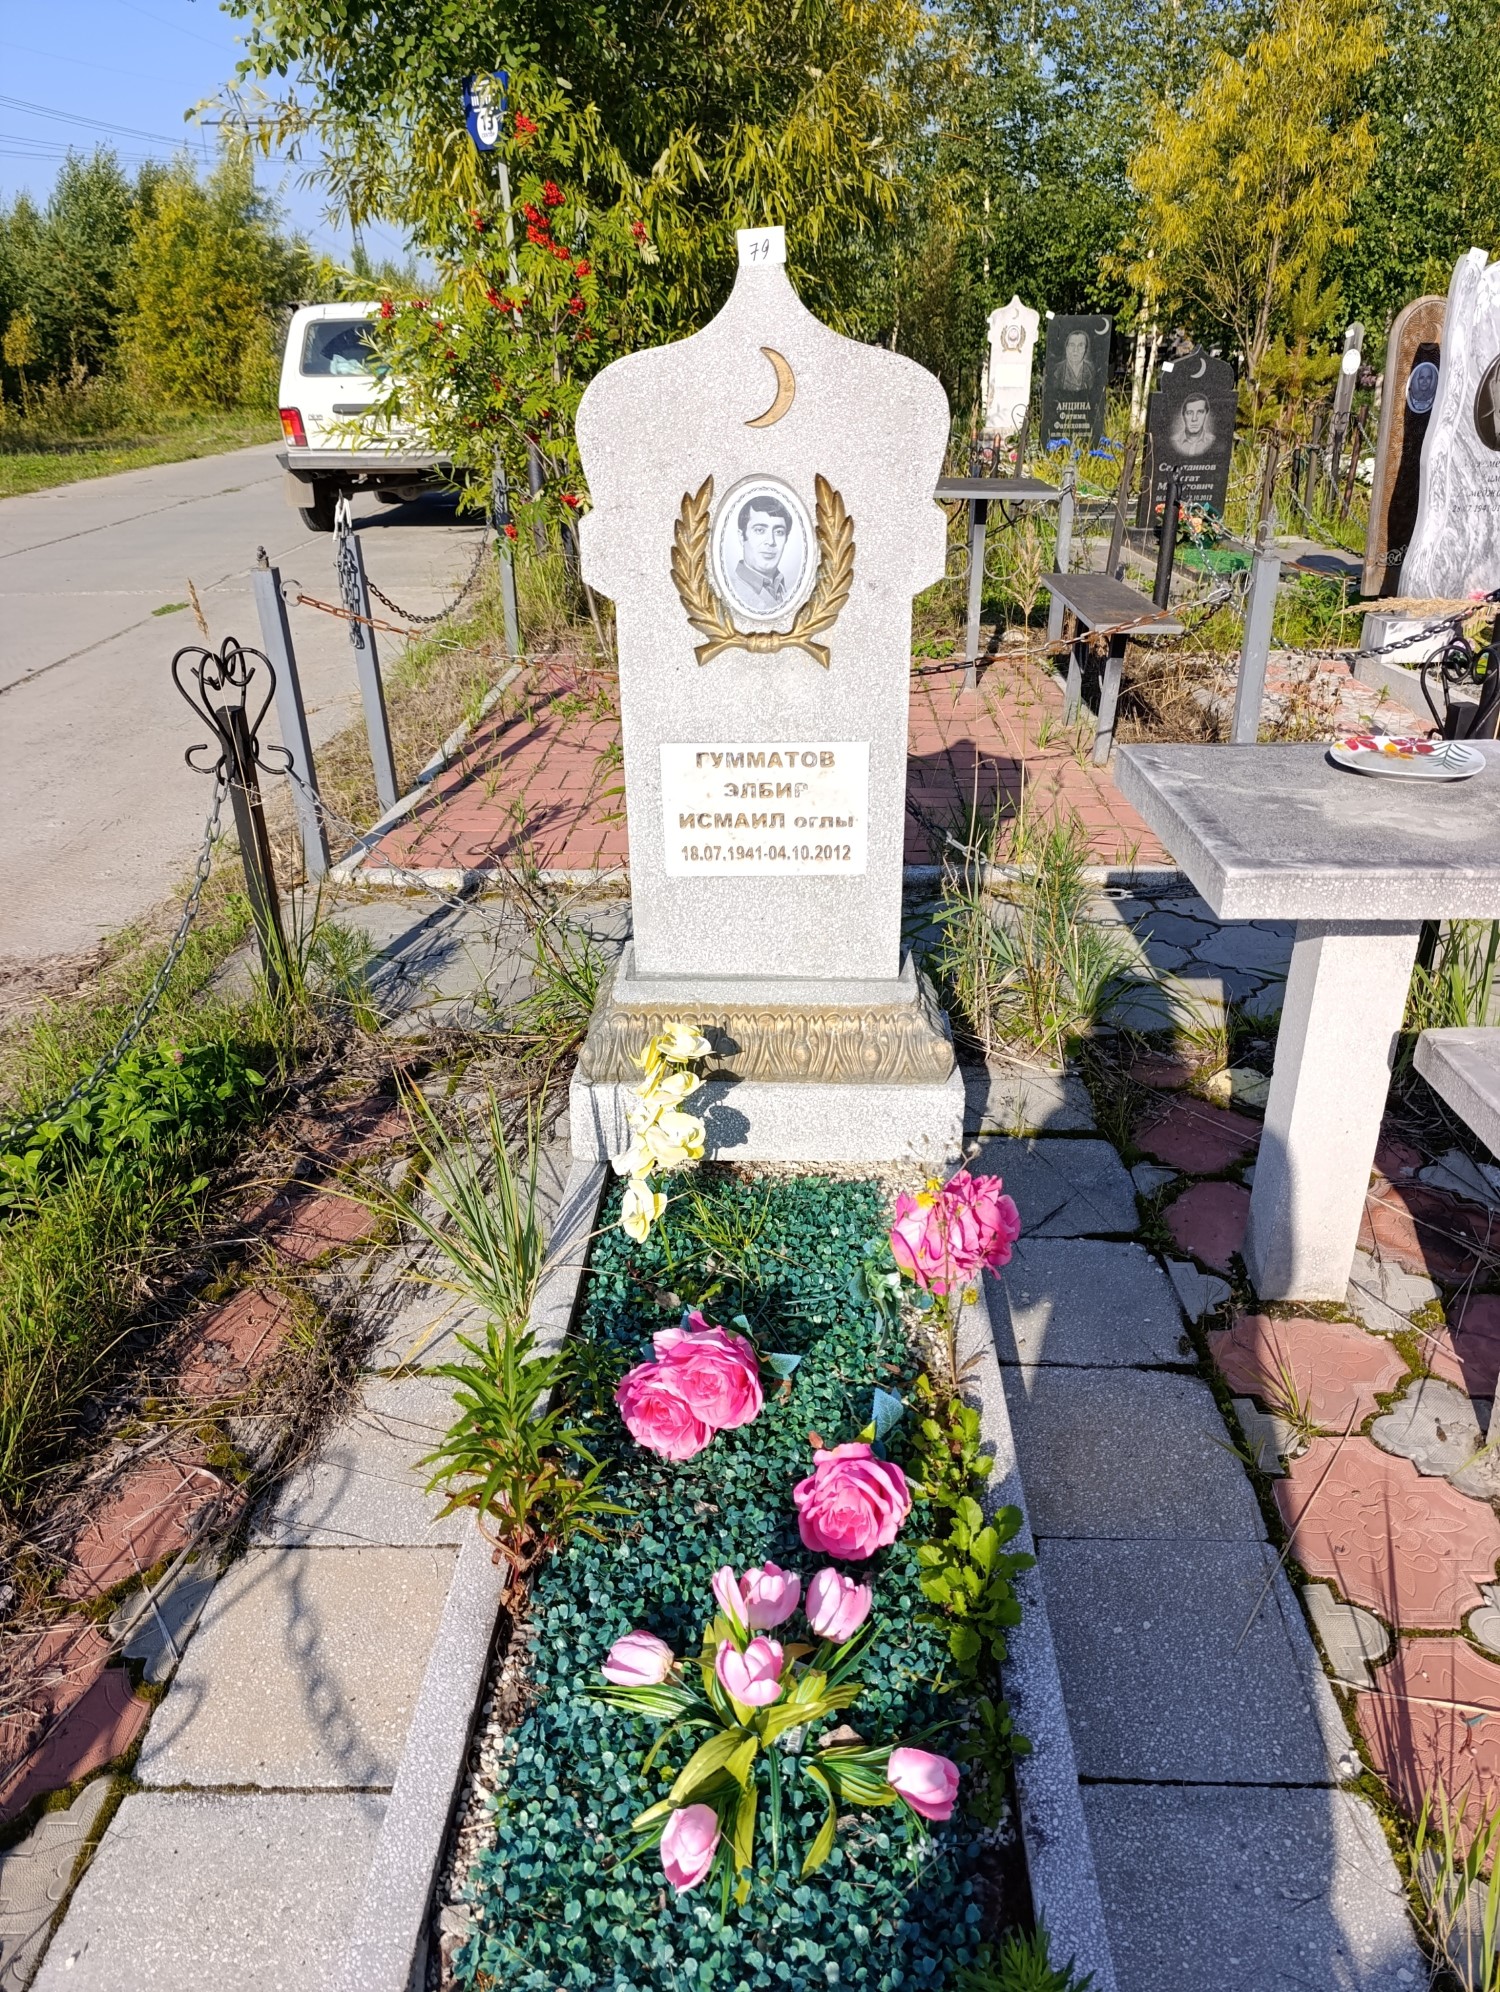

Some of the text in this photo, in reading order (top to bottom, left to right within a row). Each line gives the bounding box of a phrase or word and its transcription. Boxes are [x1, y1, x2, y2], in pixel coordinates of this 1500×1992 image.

[749, 238, 770, 261] 79
[1056, 401, 1091, 411] АНЦИНА
[695, 751, 836, 768] ГУММАТОВ
[723, 782, 809, 799] ЭЛБИР
[678, 812, 785, 829] ИСМАИЛ
[793, 816, 854, 829] оглы
[681, 844, 851, 861] 18.07.1941-04.10.2012
